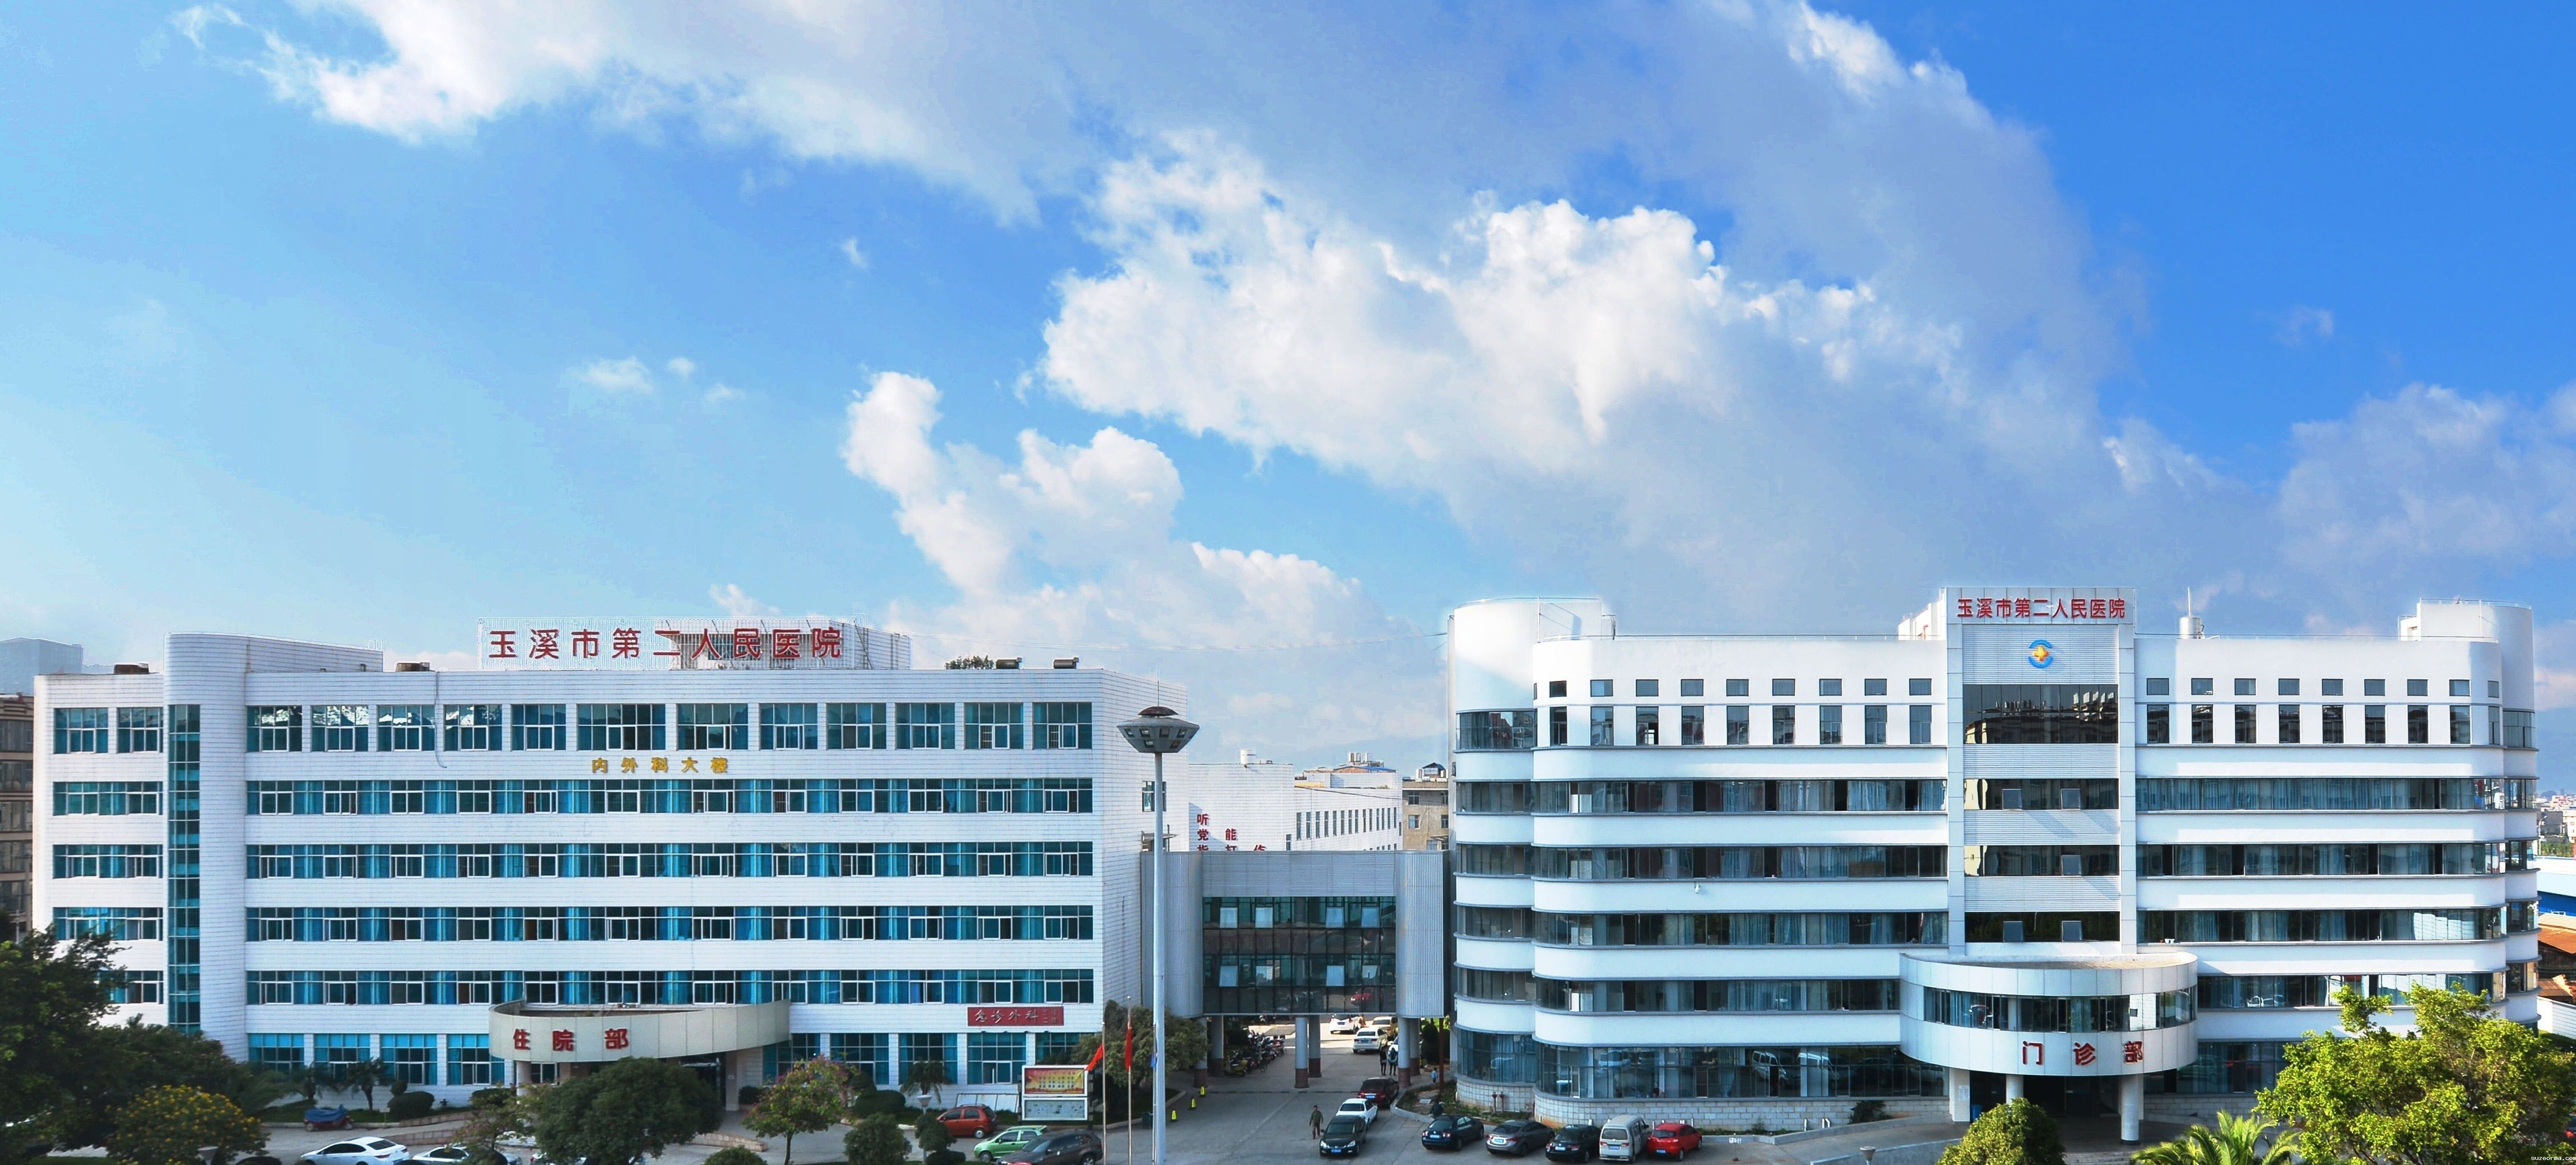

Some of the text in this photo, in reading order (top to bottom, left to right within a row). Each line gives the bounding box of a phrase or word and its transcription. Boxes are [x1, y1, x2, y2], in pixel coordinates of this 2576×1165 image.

[1957, 597, 2125, 619] 玉溪市第二人民医院
[489, 627, 843, 660] 玉溪市第二人民医院
[592, 757, 728, 773] 内外科大楼
[975, 1009, 1038, 1024] 急诊外科
[513, 1028, 629, 1051] 住院部
[2022, 1041, 2144, 1065] 门诊部
